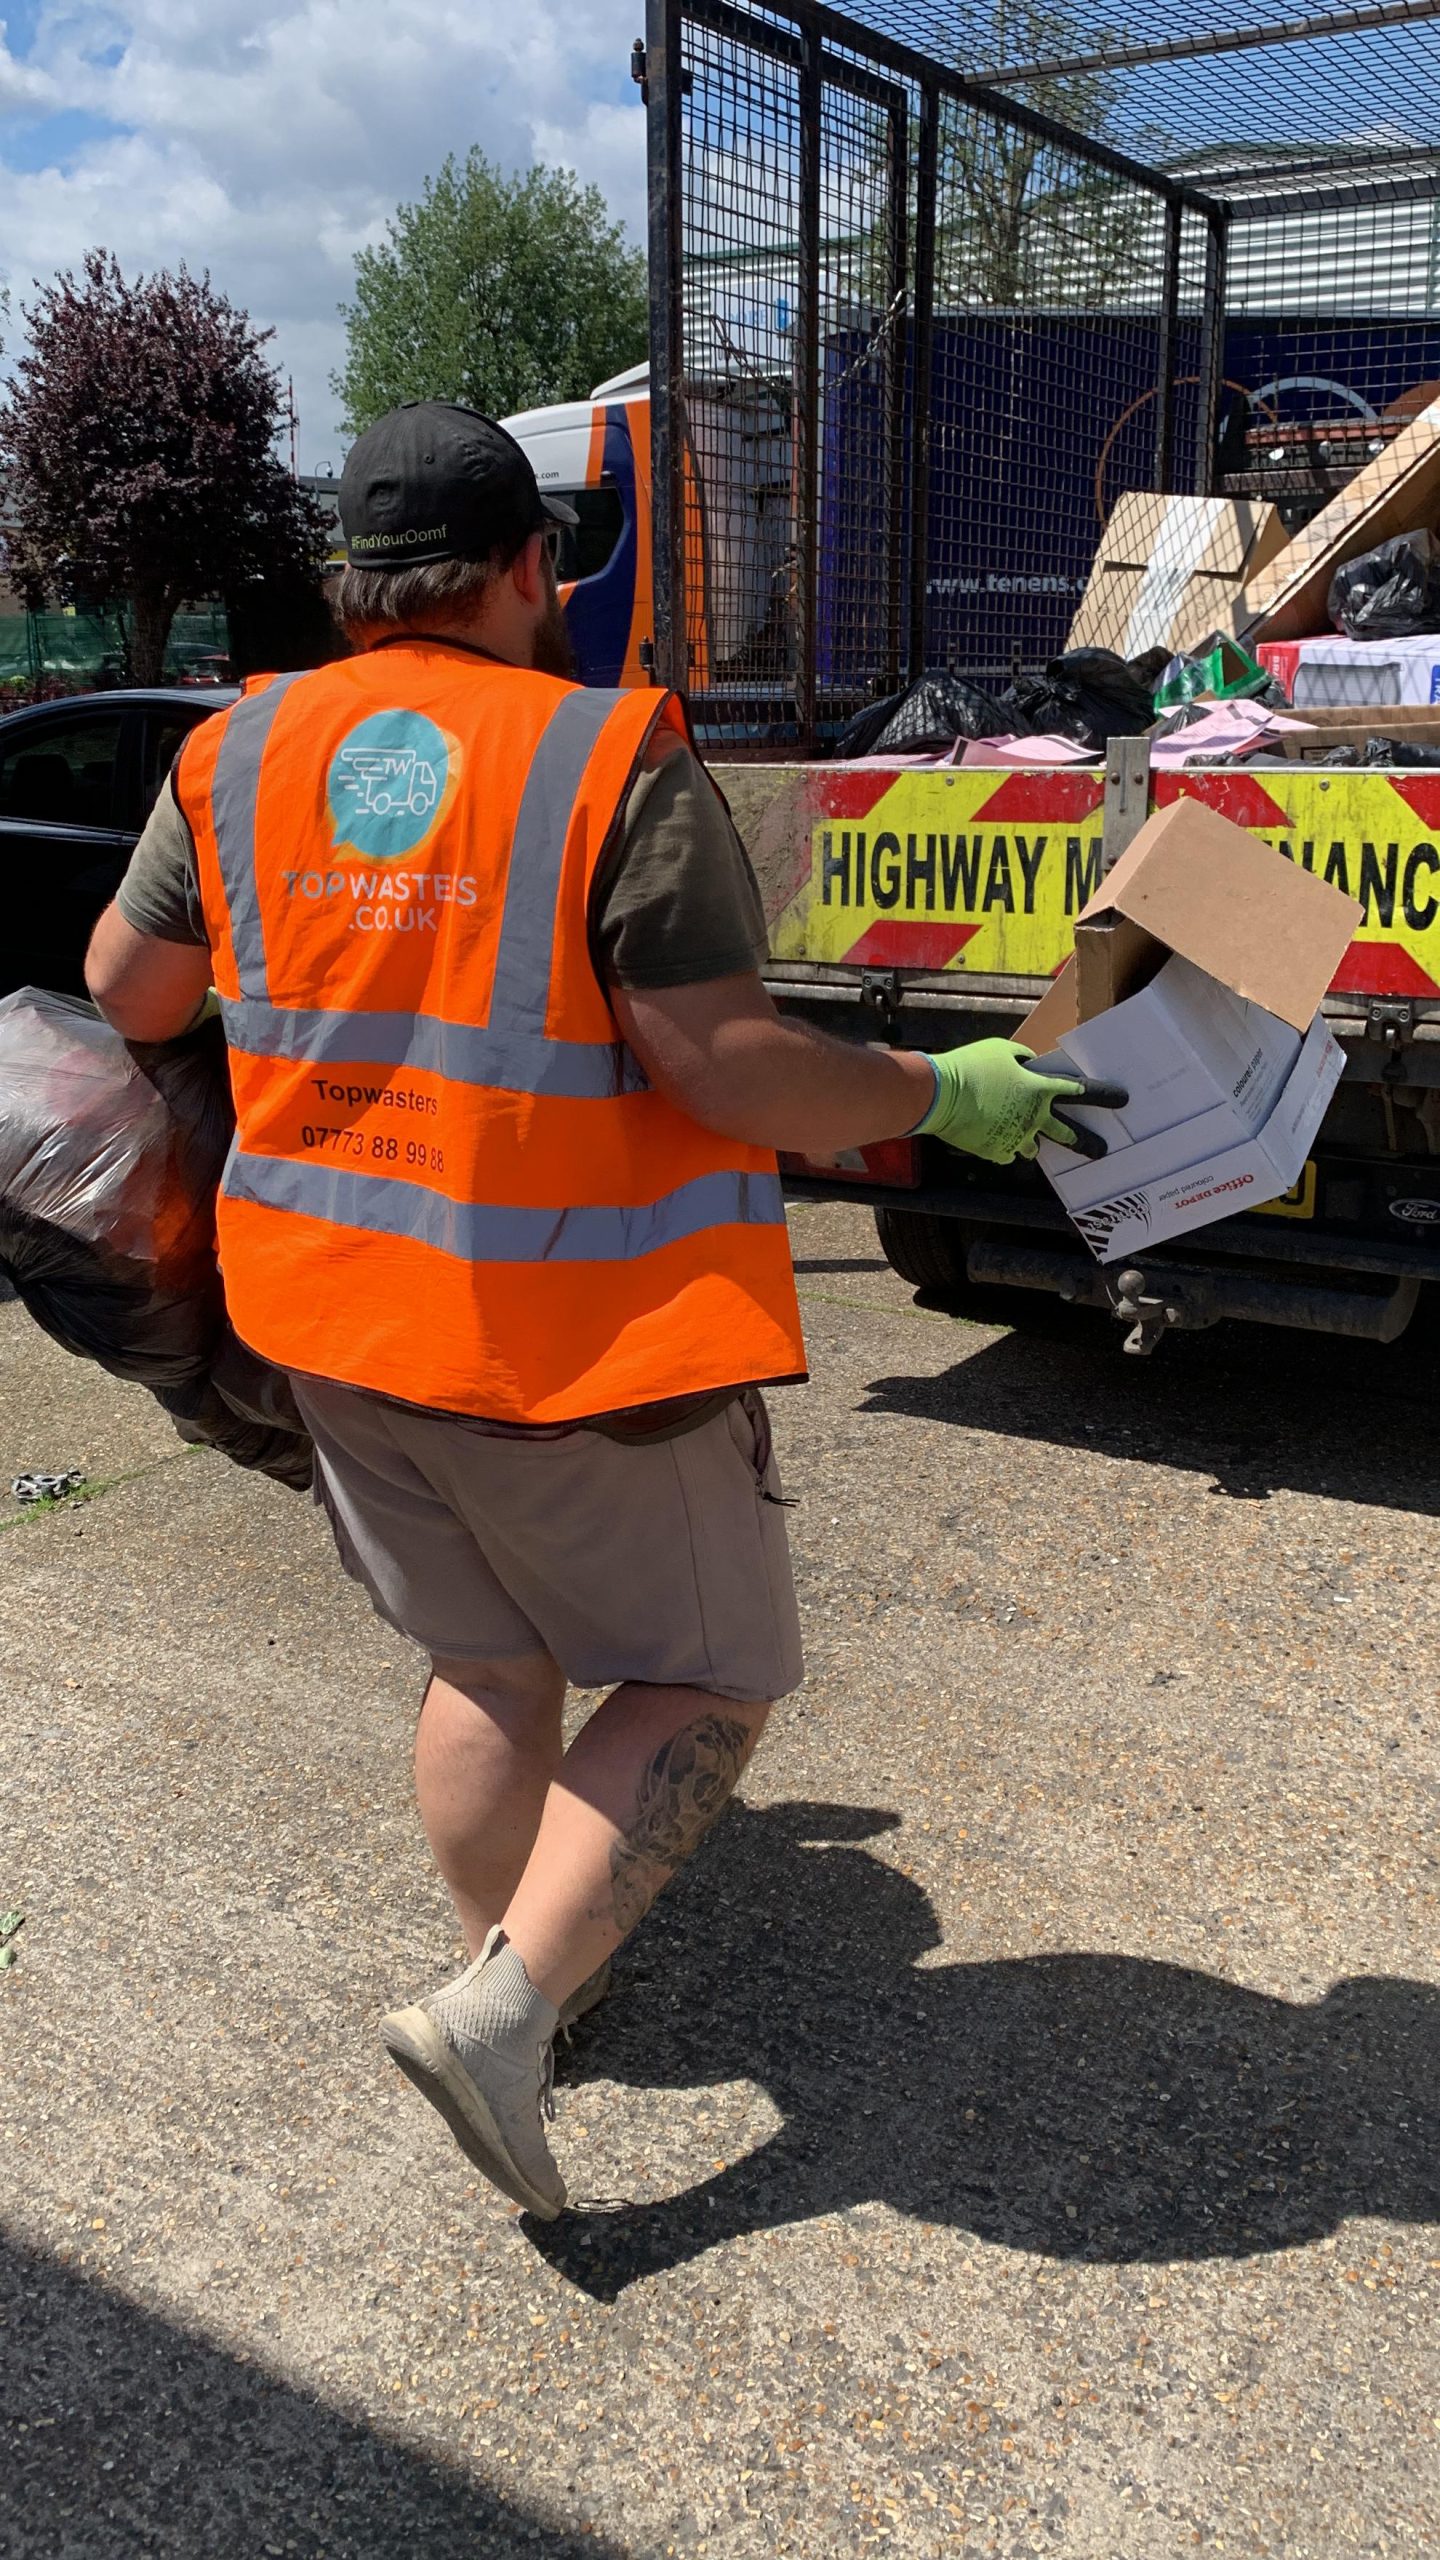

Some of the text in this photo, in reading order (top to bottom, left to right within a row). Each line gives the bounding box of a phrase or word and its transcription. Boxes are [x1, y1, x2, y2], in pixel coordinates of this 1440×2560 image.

[351, 524, 448, 550] #FindYourOomf
[822, 832, 1049, 915] HIGHWAY
[348, 905, 438, 932] .CO.UK
[311, 1079, 438, 1115] Topwasters
[302, 1125, 445, 1174] 07773 88 99 88
[1213, 1174, 1255, 1195] Office
[1401, 1202, 1437, 1220] Ford
